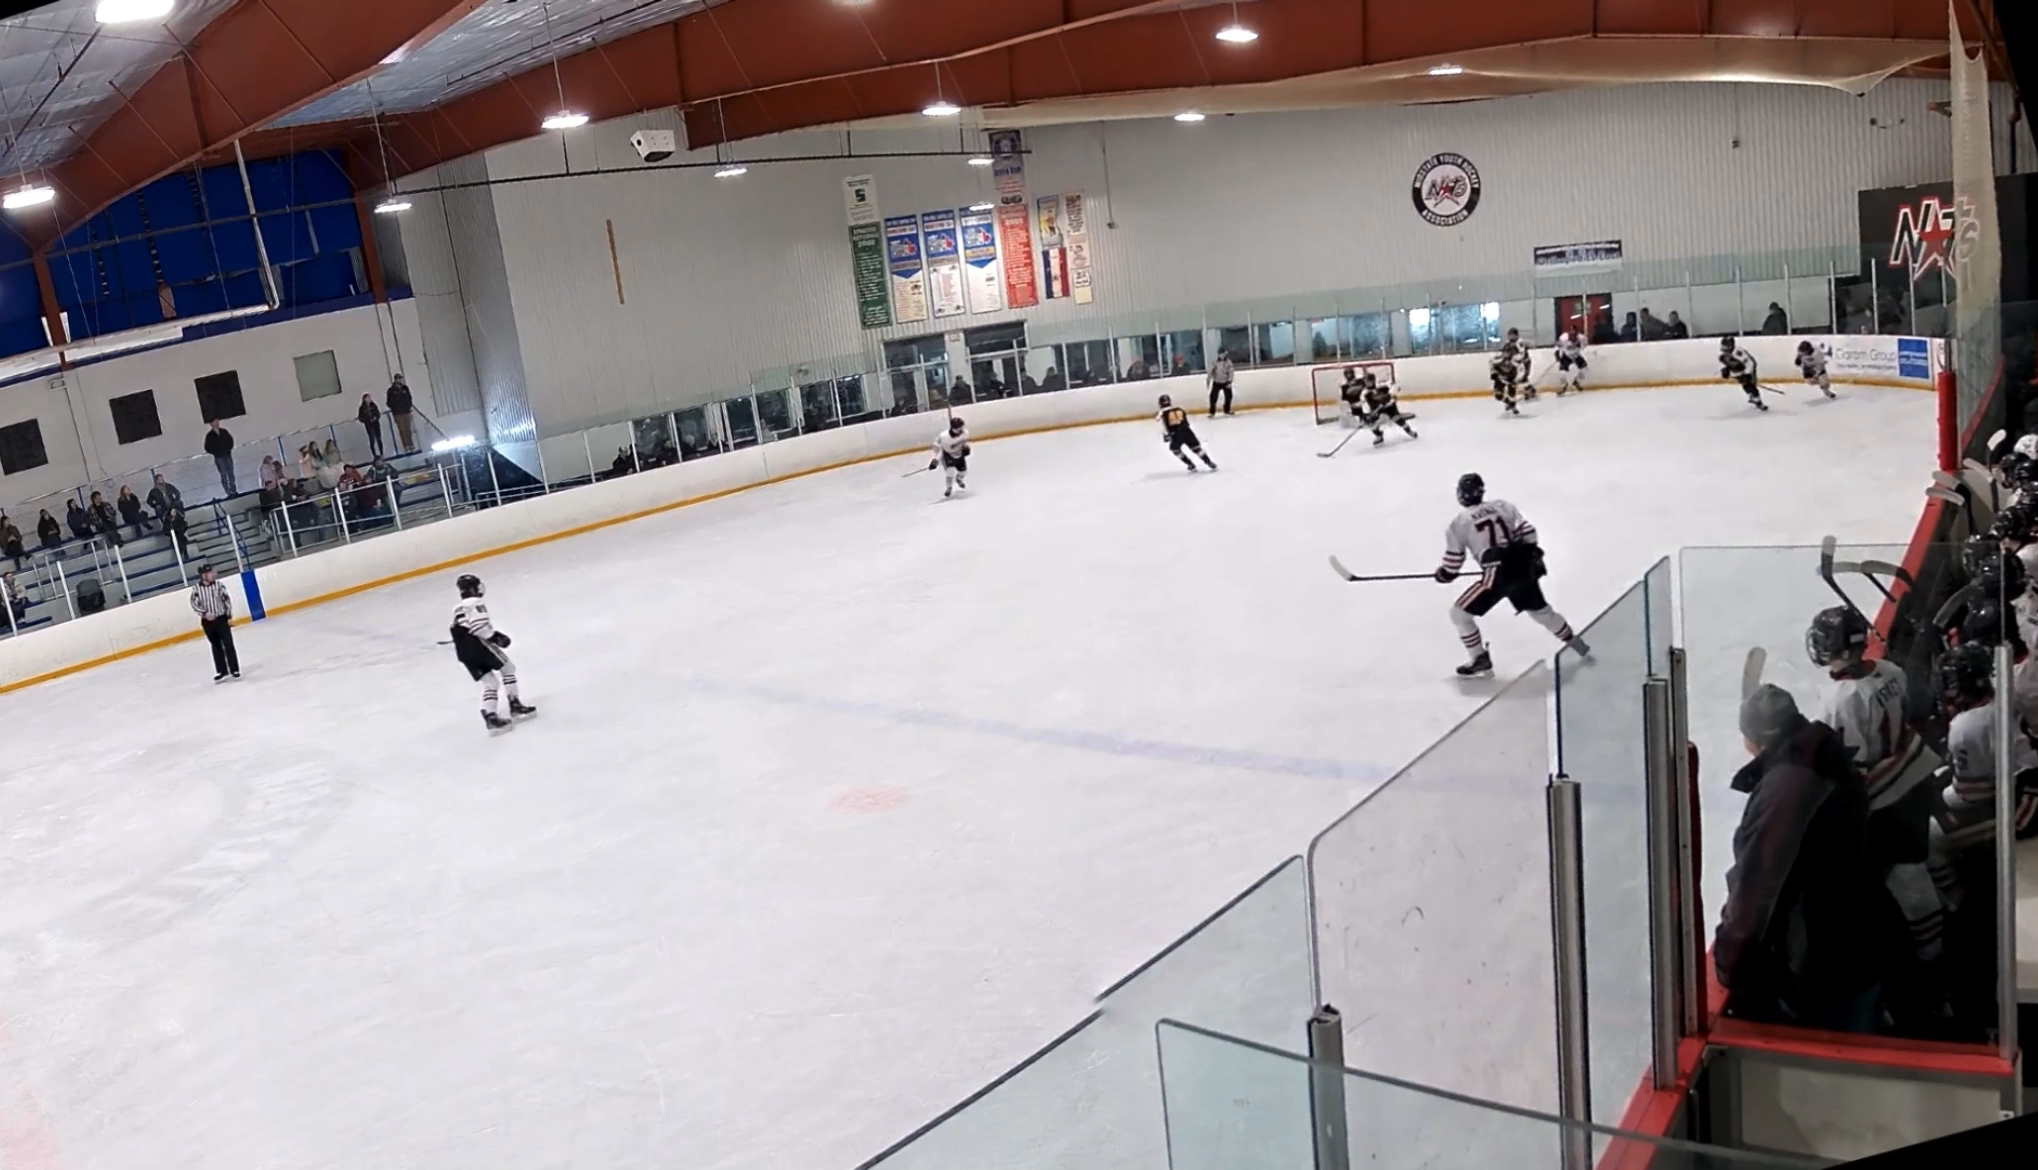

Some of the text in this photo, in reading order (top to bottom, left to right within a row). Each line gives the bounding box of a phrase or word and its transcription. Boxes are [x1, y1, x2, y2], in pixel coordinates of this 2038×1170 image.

[1439, 154, 1463, 167] YOUTH
[1462, 160, 1480, 188] HOCKEY
[1421, 209, 1470, 225] ASSOCIATION
[1869, 348, 1897, 362] Group
[1474, 515, 1511, 547] 71
